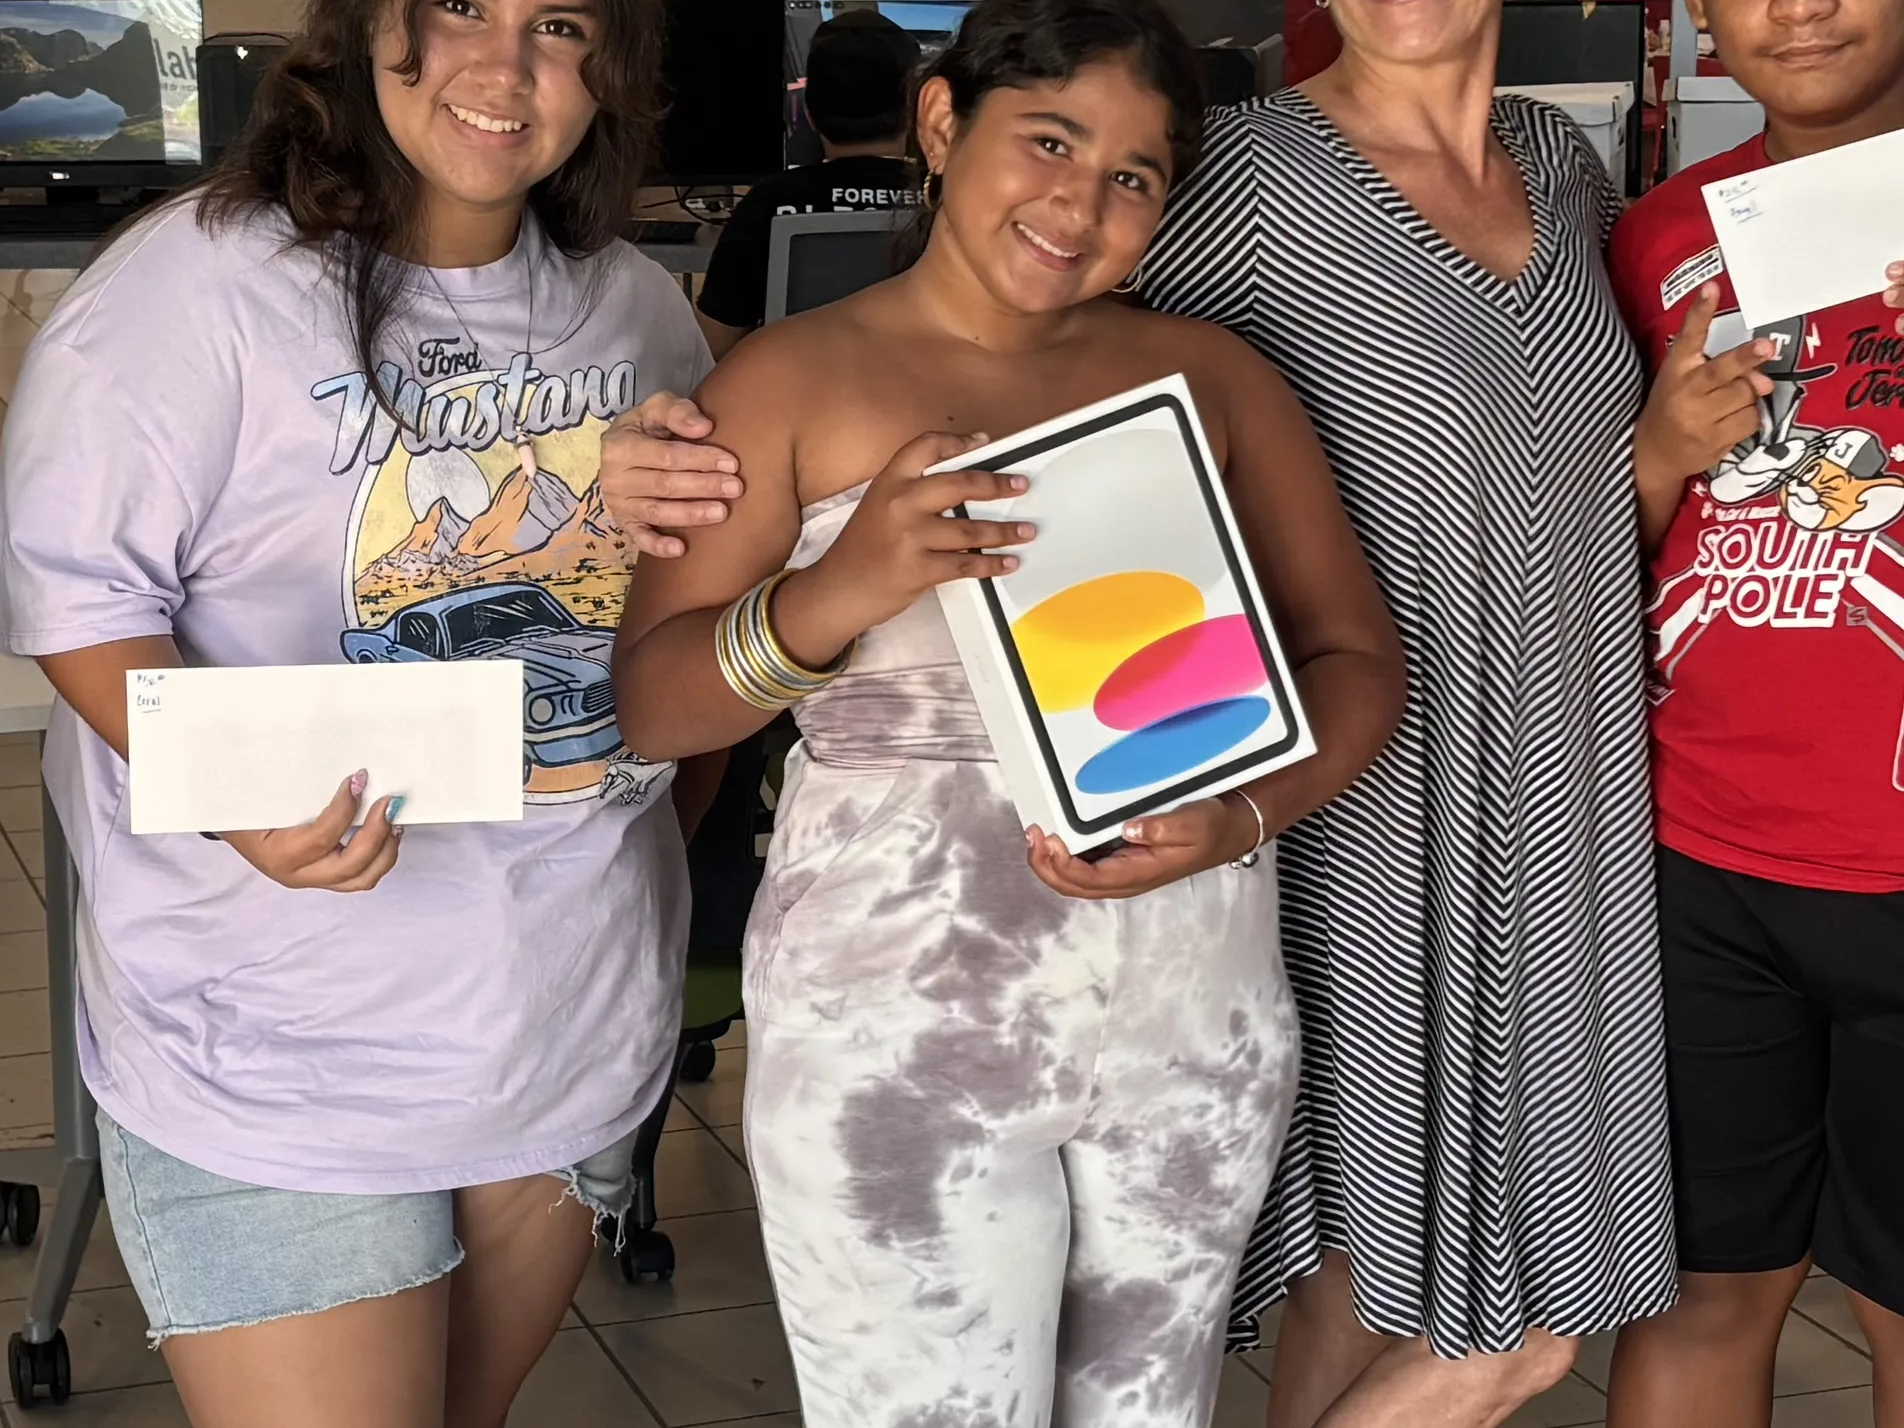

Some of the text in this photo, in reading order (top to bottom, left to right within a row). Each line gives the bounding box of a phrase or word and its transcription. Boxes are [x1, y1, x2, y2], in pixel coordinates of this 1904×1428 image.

[417, 336, 483, 377] Ford
[1769, 332, 1792, 361] T
[1834, 442, 1853, 459] J
[1694, 521, 1880, 578] SOUTH
[1698, 572, 1846, 629] POLE
